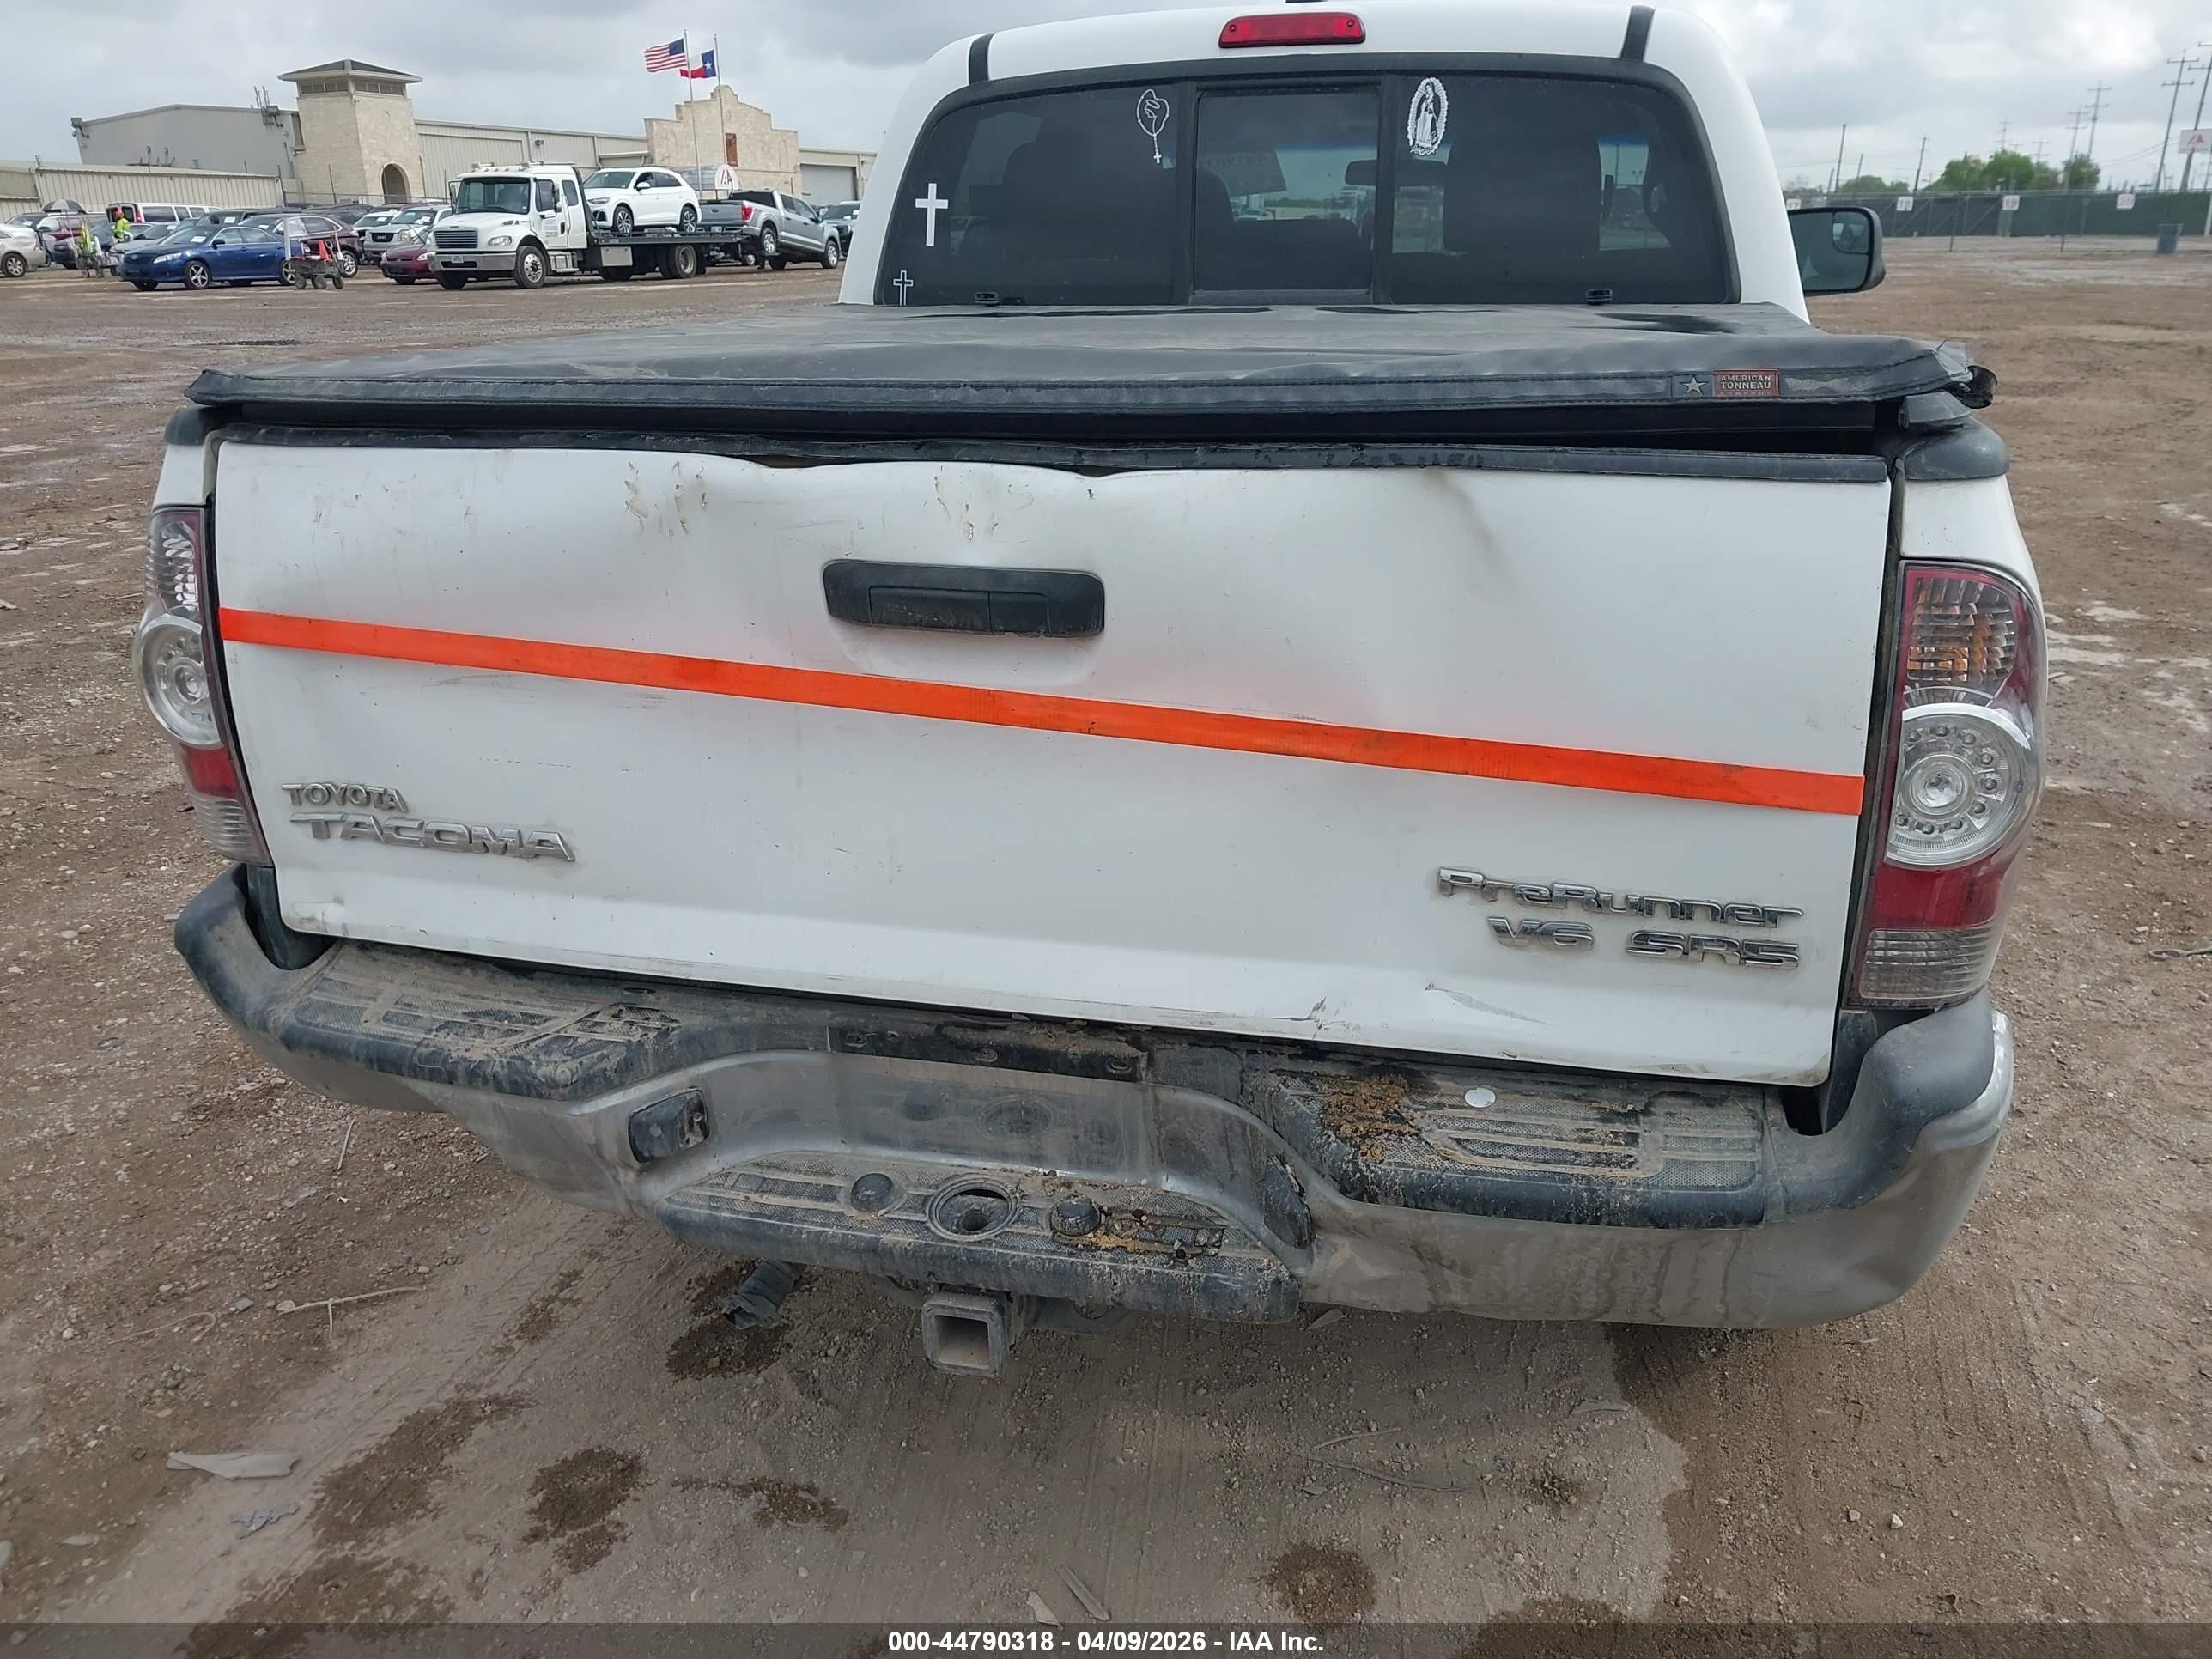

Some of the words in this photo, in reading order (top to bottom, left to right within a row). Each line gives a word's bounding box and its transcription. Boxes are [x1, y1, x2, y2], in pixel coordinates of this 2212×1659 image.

[1721, 381, 1771, 390] TONNEAU
[282, 782, 410, 813] TOYOTA
[289, 811, 576, 862] TACOMA
[1438, 866, 1804, 929] PreRunner
[1487, 915, 1595, 951] V6
[1627, 930, 1800, 970] SR5
